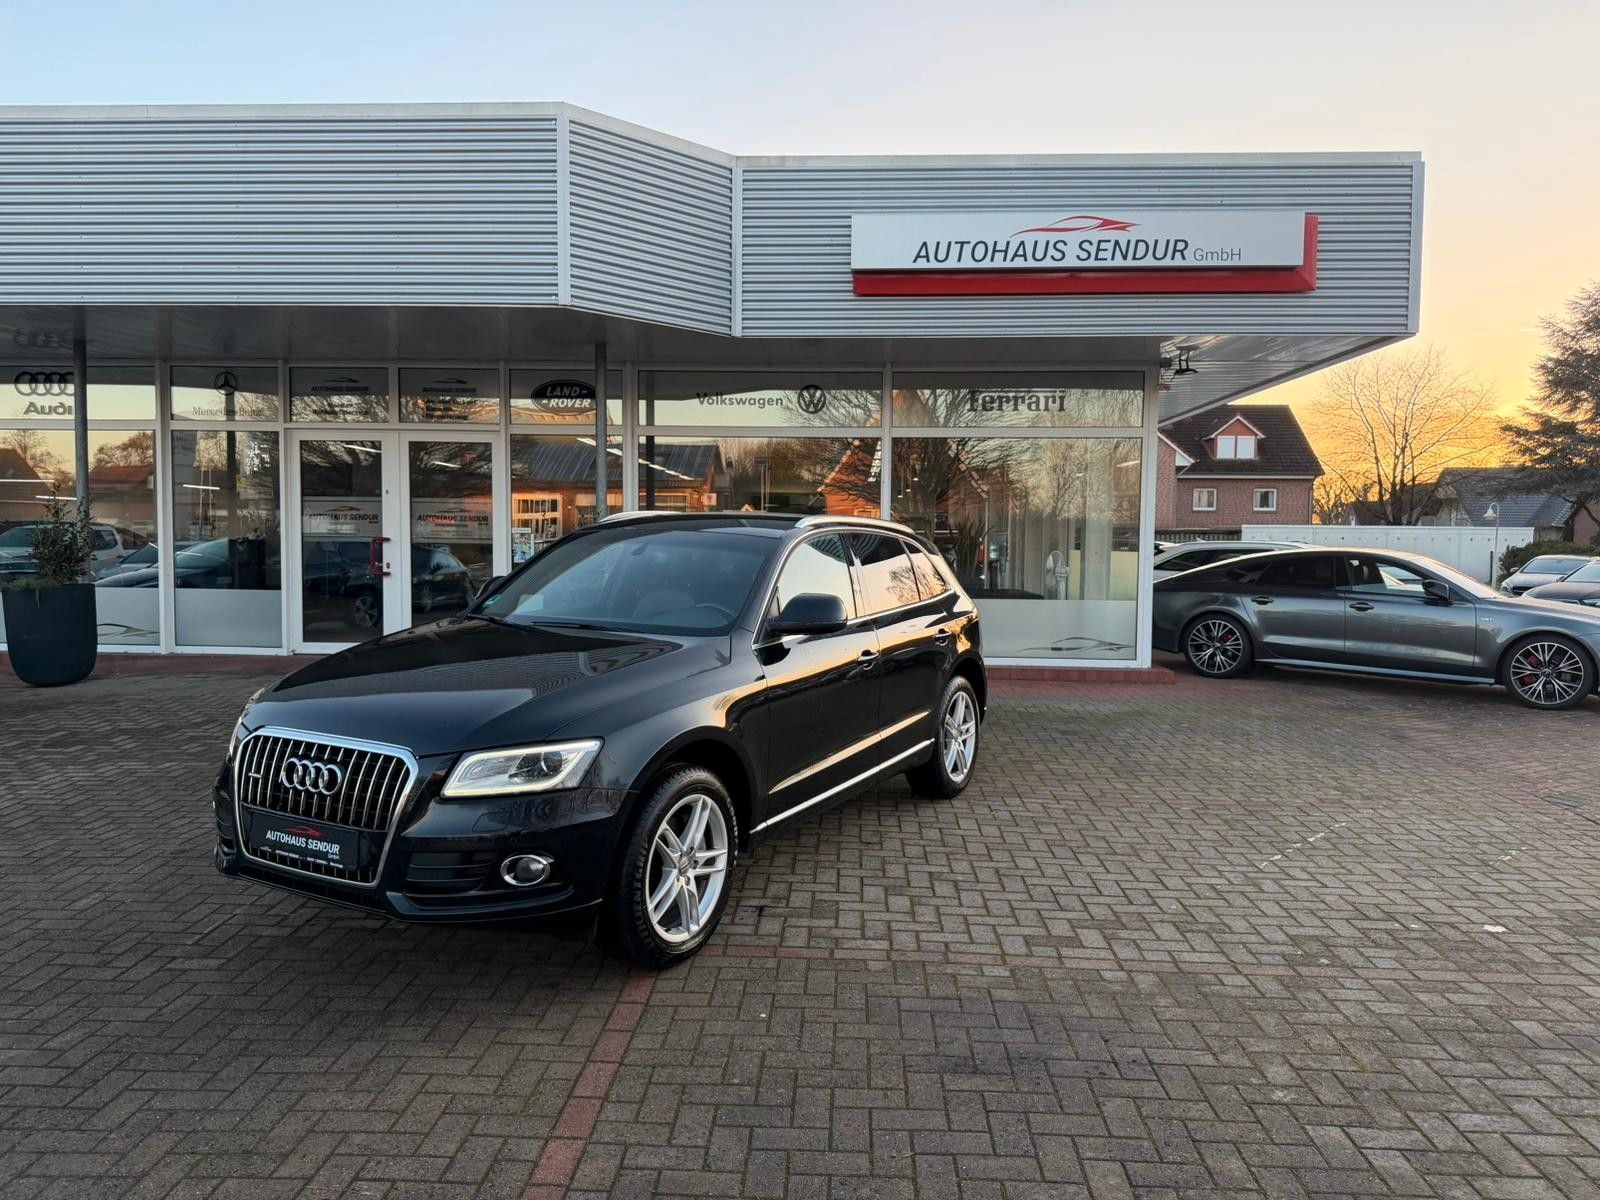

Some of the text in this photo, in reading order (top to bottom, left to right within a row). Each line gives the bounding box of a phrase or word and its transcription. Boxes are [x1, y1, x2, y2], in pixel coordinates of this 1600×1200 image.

[913, 239, 1241, 263] AUTOHAUS SENDUR GmbH
[23, 401, 73, 416] Audi
[549, 398, 591, 408] ROVER
[696, 392, 784, 409] Volkswagen
[967, 389, 1066, 412] Ferrari
[349, 513, 379, 521] SENDUR
[417, 513, 457, 522] AUTOHAUS
[265, 829, 306, 847] AUTOHAUS
[307, 838, 340, 855] SENDUR
